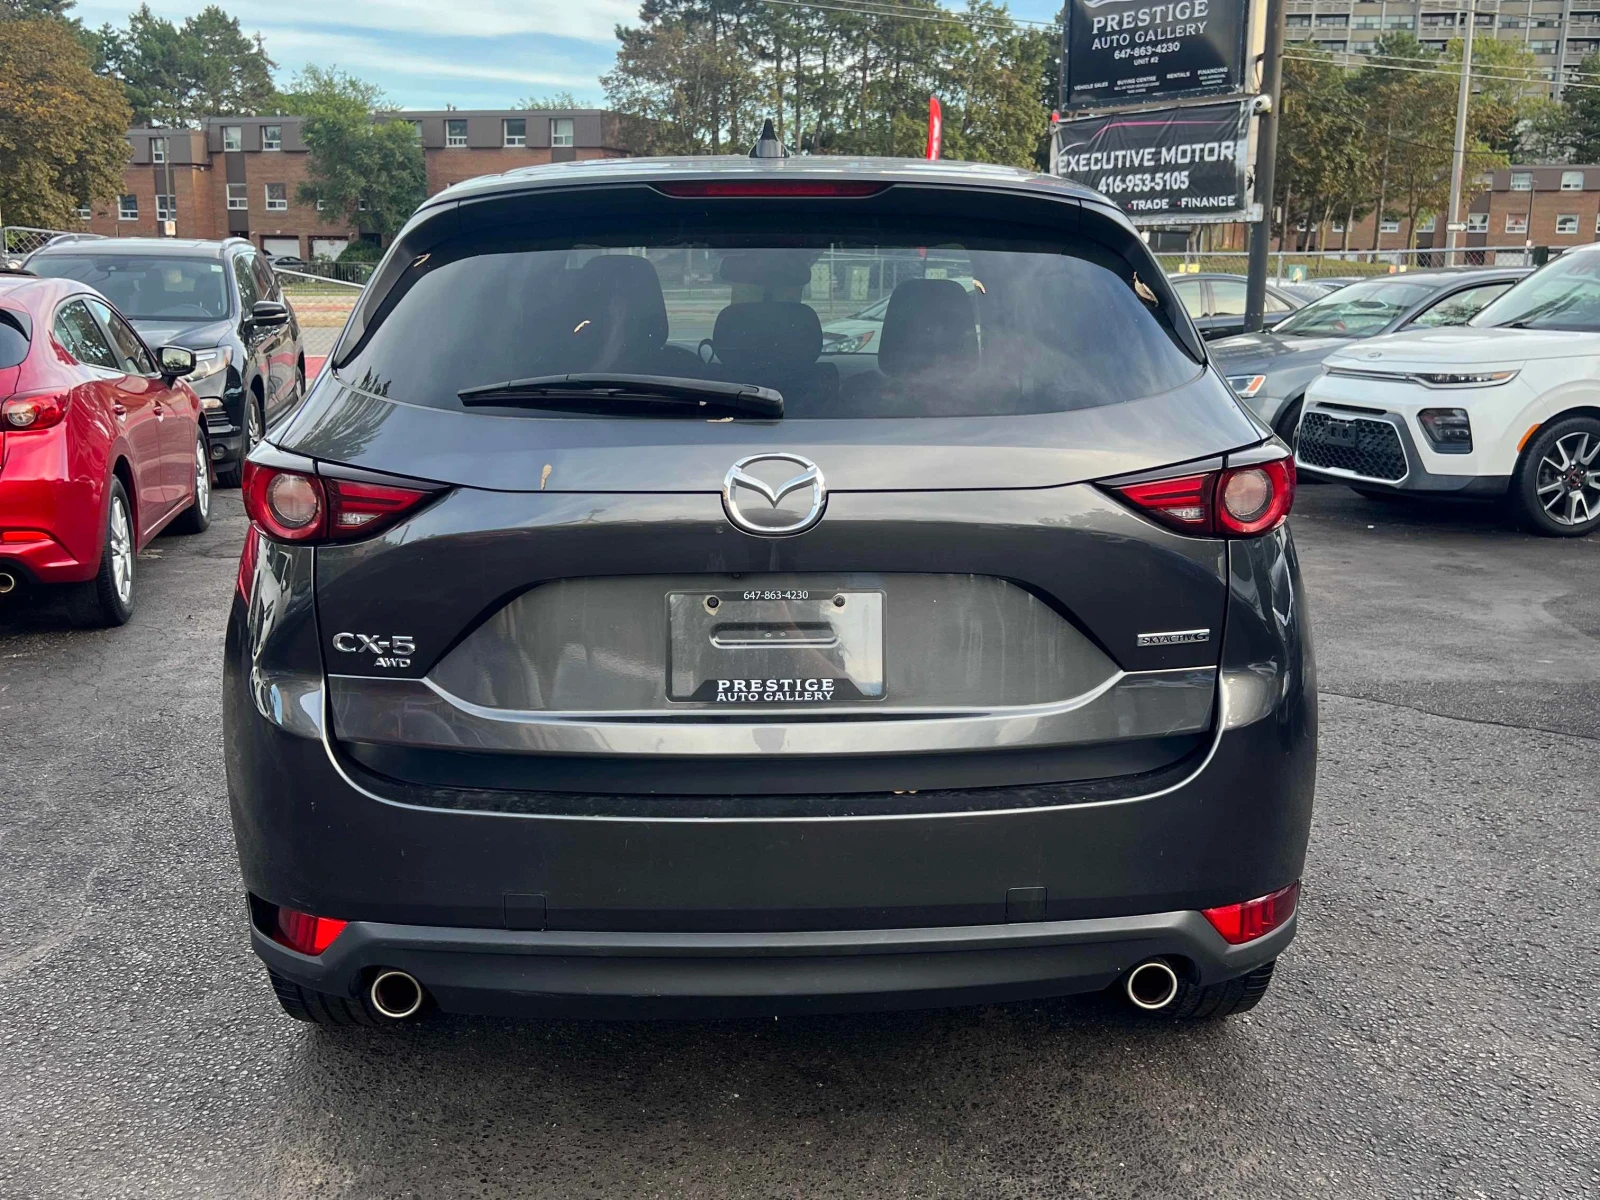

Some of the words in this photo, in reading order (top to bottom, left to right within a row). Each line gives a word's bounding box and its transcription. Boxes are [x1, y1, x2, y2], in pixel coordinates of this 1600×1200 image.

[1092, 0, 1209, 34] PRESTIGE
[1092, 34, 1130, 50] AUTO
[1135, 21, 1207, 43] GALLERY
[1114, 42, 1181, 60] 647-863-4230
[1133, 58, 1149, 66] UNIT
[1197, 66, 1228, 76] FINANCING
[1057, 148, 1155, 174] EXECUTIVE
[1098, 171, 1190, 194] 416-953-5105
[1131, 199, 1169, 210] TRADE
[1181, 195, 1236, 208] FINANCE
[743, 591, 809, 600] 647-863-4230
[332, 632, 416, 655] CX-5
[373, 657, 411, 668] AWD
[716, 679, 835, 692] PRESTIGE
[716, 692, 759, 702] AUTO
[763, 691, 834, 701] GALLERY
